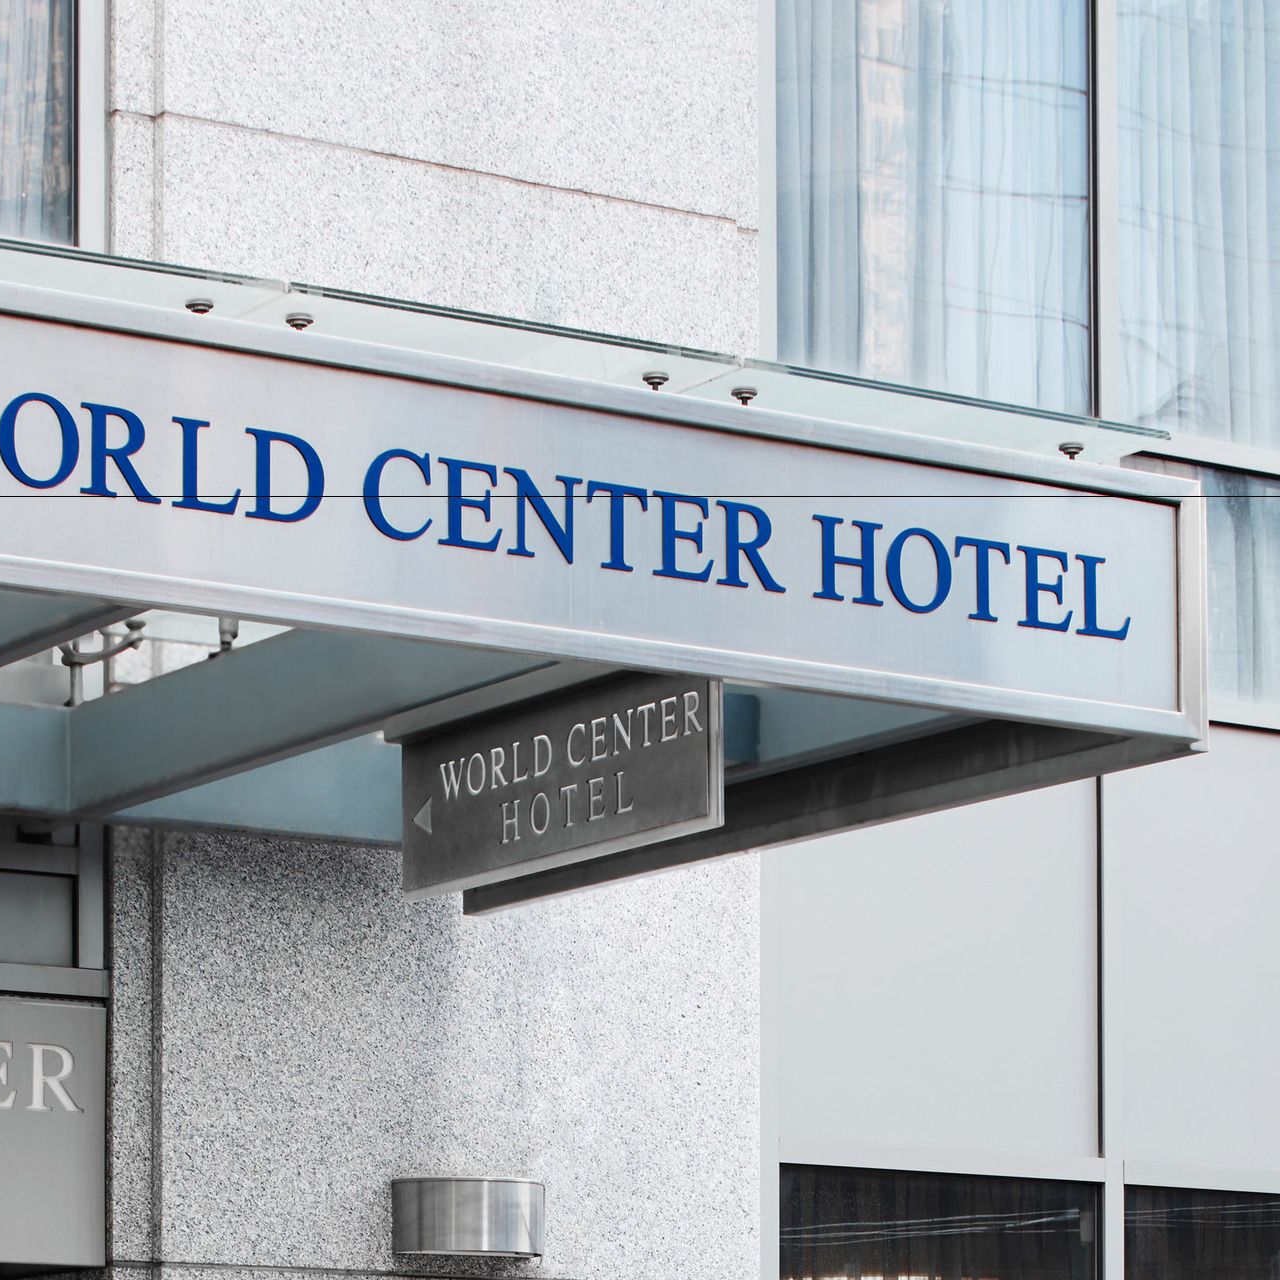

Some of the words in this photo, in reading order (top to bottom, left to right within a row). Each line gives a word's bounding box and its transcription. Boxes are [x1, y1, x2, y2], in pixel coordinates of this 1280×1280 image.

[362, 447, 787, 593] CENTER
[813, 513, 1133, 640] HOTEL
[439, 734, 553, 801] WORLD
[566, 690, 704, 768] CENTER
[500, 771, 634, 845] HOTEL
